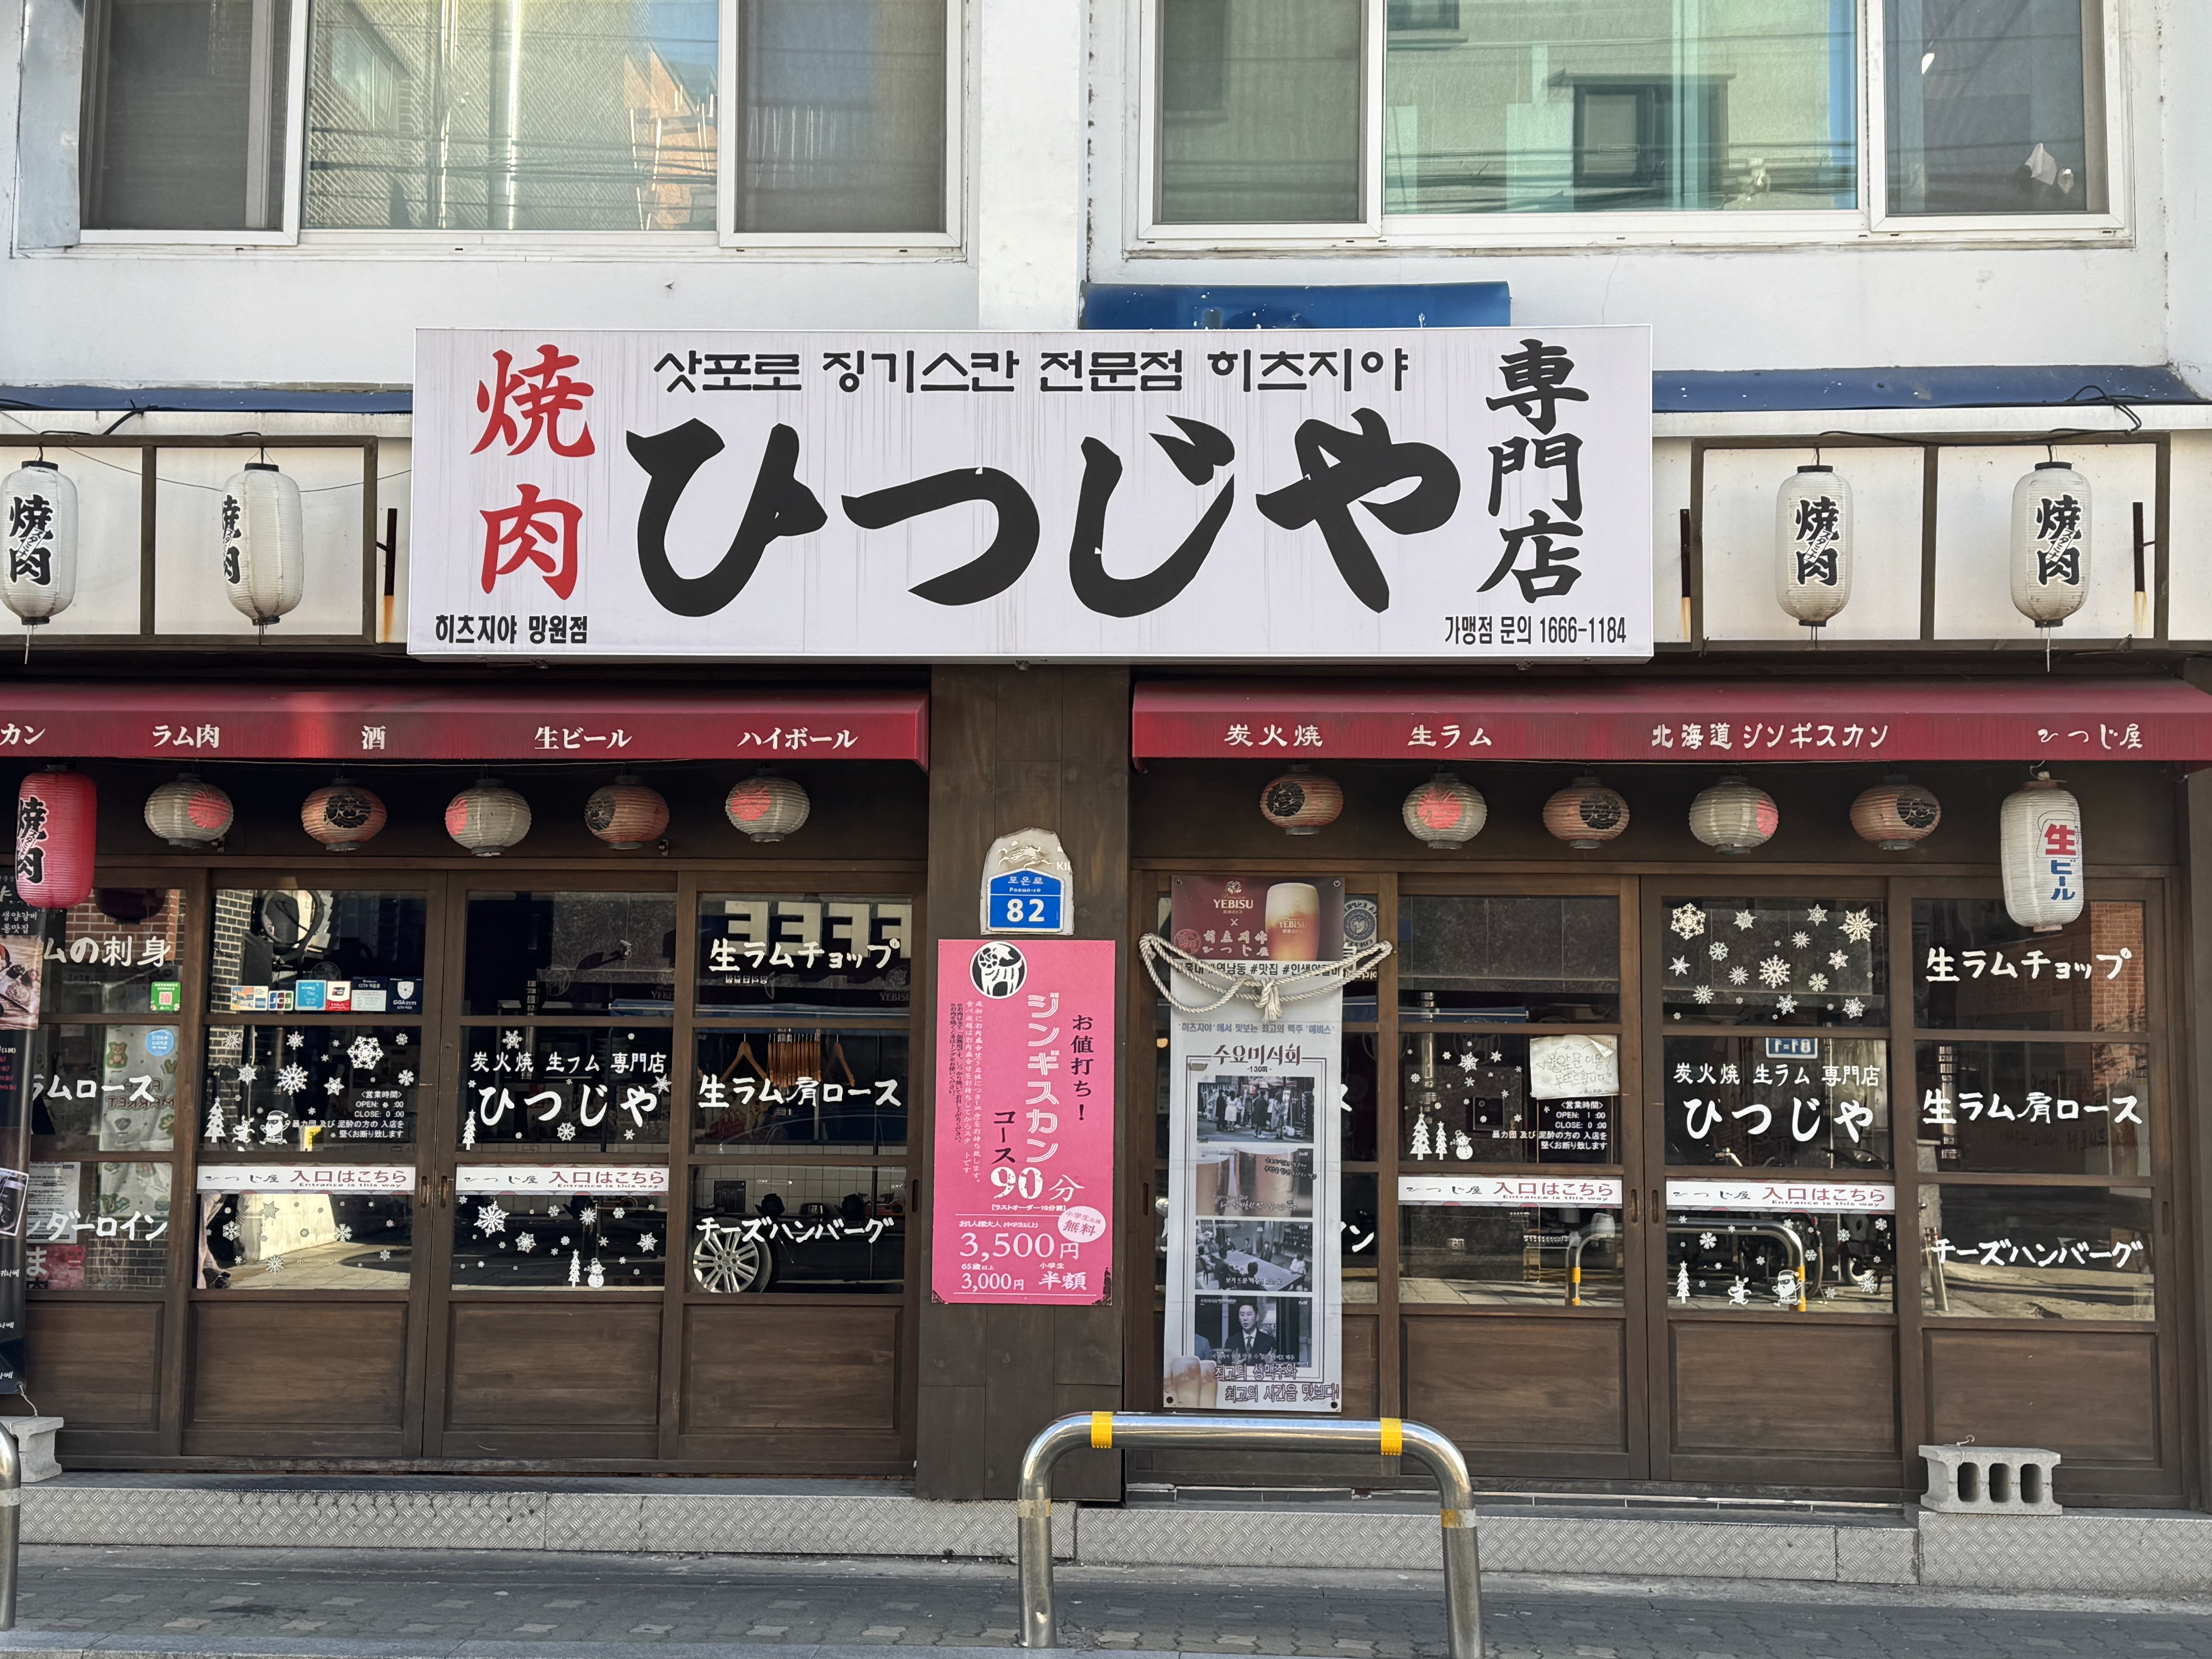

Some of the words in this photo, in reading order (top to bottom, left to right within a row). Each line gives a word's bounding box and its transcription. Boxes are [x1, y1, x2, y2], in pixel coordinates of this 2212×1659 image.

[654, 350, 802, 393] 삿포로
[823, 350, 1019, 393] 징기스칸
[1040, 350, 1183, 392] 전문점
[1207, 347, 1408, 392] 히츠지야
[470, 343, 596, 600] 焼肉
[1476, 338, 1590, 604] 専門店
[626, 407, 1461, 617] ひつじや
[10, 494, 54, 585] 焼肉
[1796, 496, 1839, 586] 焼肉
[2037, 494, 2082, 586] 焼肉
[434, 613, 517, 644] 히츠지야
[529, 613, 588, 644] 망원점
[1444, 616, 1493, 645] 가맹점
[1499, 616, 1532, 645] 문의
[1539, 616, 1627, 644] 1666-1184
[0, 723, 46, 745] カン
[153, 724, 220, 749] ラム肉
[361, 725, 385, 750] 酒
[534, 726, 632, 750] 生ビール
[737, 727, 858, 750] ハイボール
[1224, 723, 1323, 747] 炭火焼
[1408, 724, 1492, 748] 生ラム
[2037, 723, 2143, 750] ひつじ屋
[1007, 898, 1045, 922] 82
[1213, 899, 1254, 909] YEBISU
[43, 935, 171, 967] ムの刺身
[708, 937, 901, 972] 生ラムチョップ
[1925, 946, 2133, 982] 生ラムチョップ
[1250, 963, 1278, 976] #맛집
[471, 1051, 534, 1072] 炭火焼
[610, 1051, 667, 1074] 専門店
[1212, 1043, 1301, 1066] 수요미식회
[1025, 992, 1060, 1163] ジンギスカン
[1673, 1062, 1740, 1085] 炭火焼
[1753, 1063, 1810, 1086] 生ラム
[1821, 1064, 1881, 1087] 専門店
[698, 1073, 902, 1108] 生ラム肩ロース
[479, 1084, 658, 1128] ひつじや
[1922, 1088, 2143, 1124] 生ラム肩ロース
[1683, 1097, 1874, 1144] ひつじや
[991, 1110, 1017, 1164] コース
[290, 1170, 407, 1183] 入口はこちら
[548, 1170, 665, 1185] 入口はこちら
[990, 1166, 1086, 1202] 90分
[1493, 1181, 1614, 1196] 入口はこちら
[1762, 1187, 1886, 1202] 入口はこちら
[696, 1216, 895, 1244] チーズハンバーグ
[1063, 1219, 1096, 1237] 無料
[959, 1232, 1080, 1262] 3,500円
[1930, 1238, 2144, 1268] チーズハンバーグ
[961, 1273, 1025, 1293] 3,000円
[1038, 1271, 1087, 1291] 半額
[1225, 1384, 1258, 1403] 최고의
[1264, 1384, 1298, 1402] 시간을
